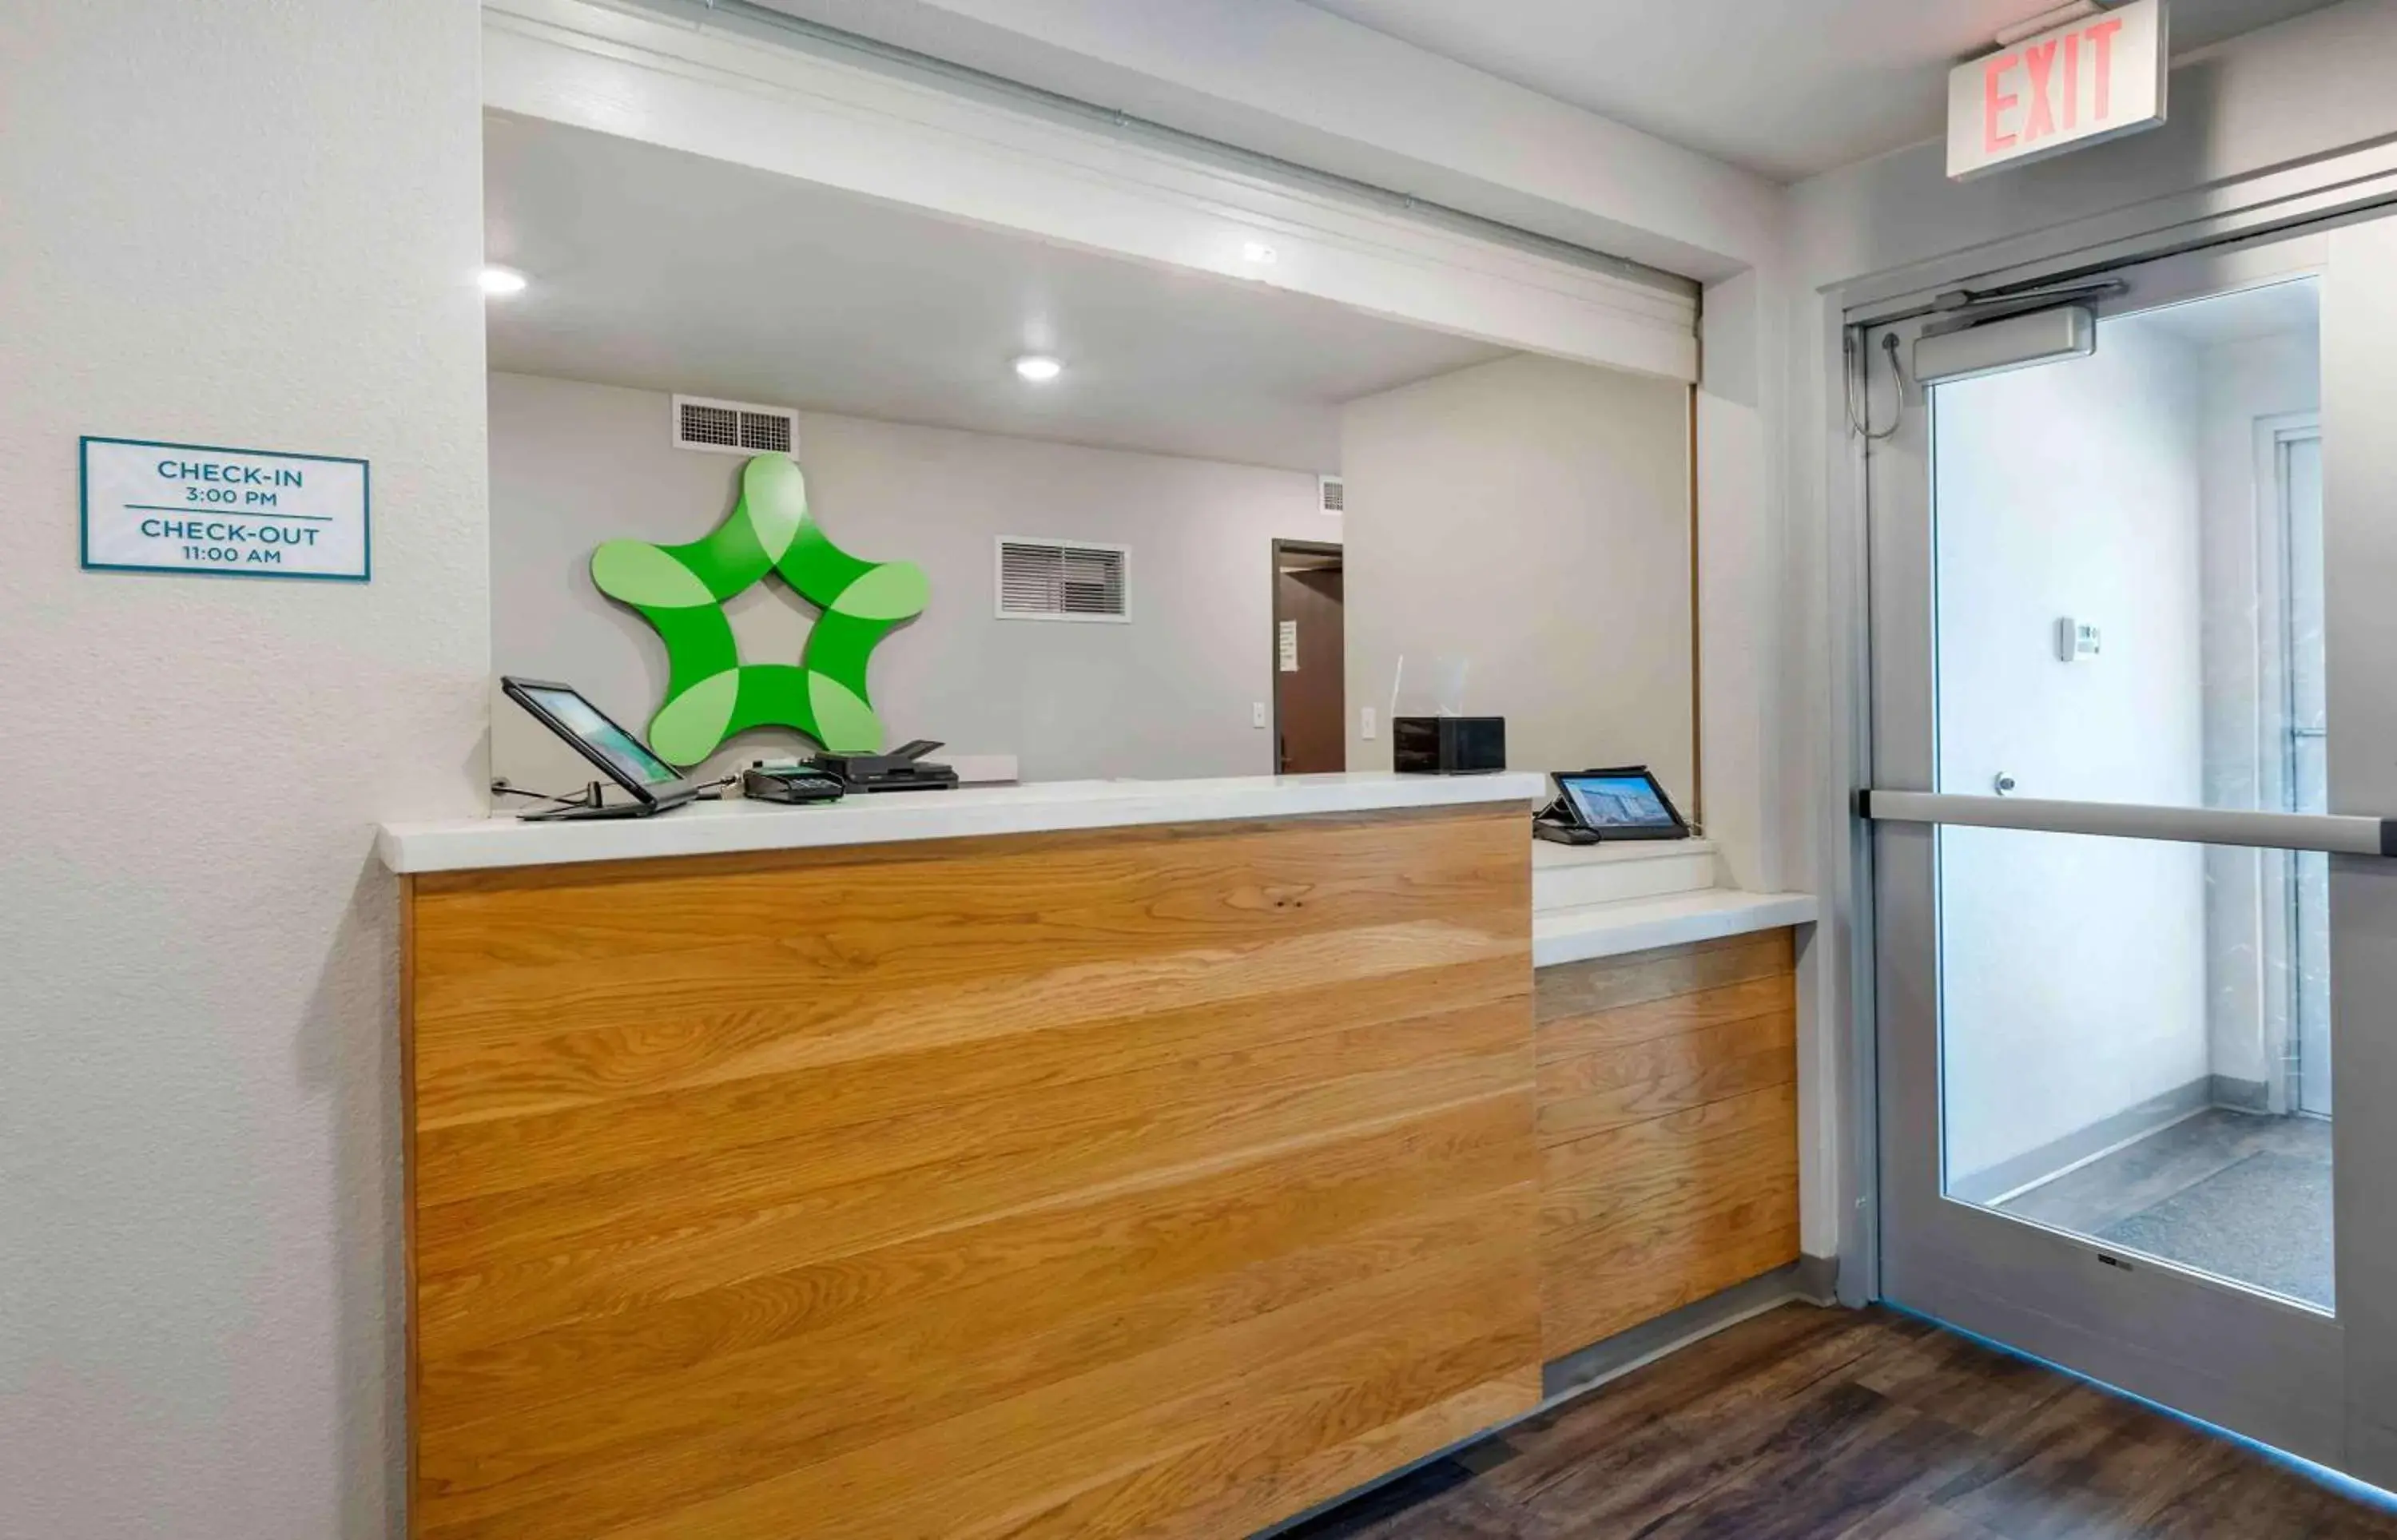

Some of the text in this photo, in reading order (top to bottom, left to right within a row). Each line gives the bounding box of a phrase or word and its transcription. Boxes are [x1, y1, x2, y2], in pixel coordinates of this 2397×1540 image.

[1984, 18, 2122, 154] EXIT
[157, 461, 303, 487] CHECK-IN
[185, 486, 277, 506] 3:00 PM
[141, 519, 320, 546] CHECK-OUT
[182, 546, 281, 563] 11:00 AM
